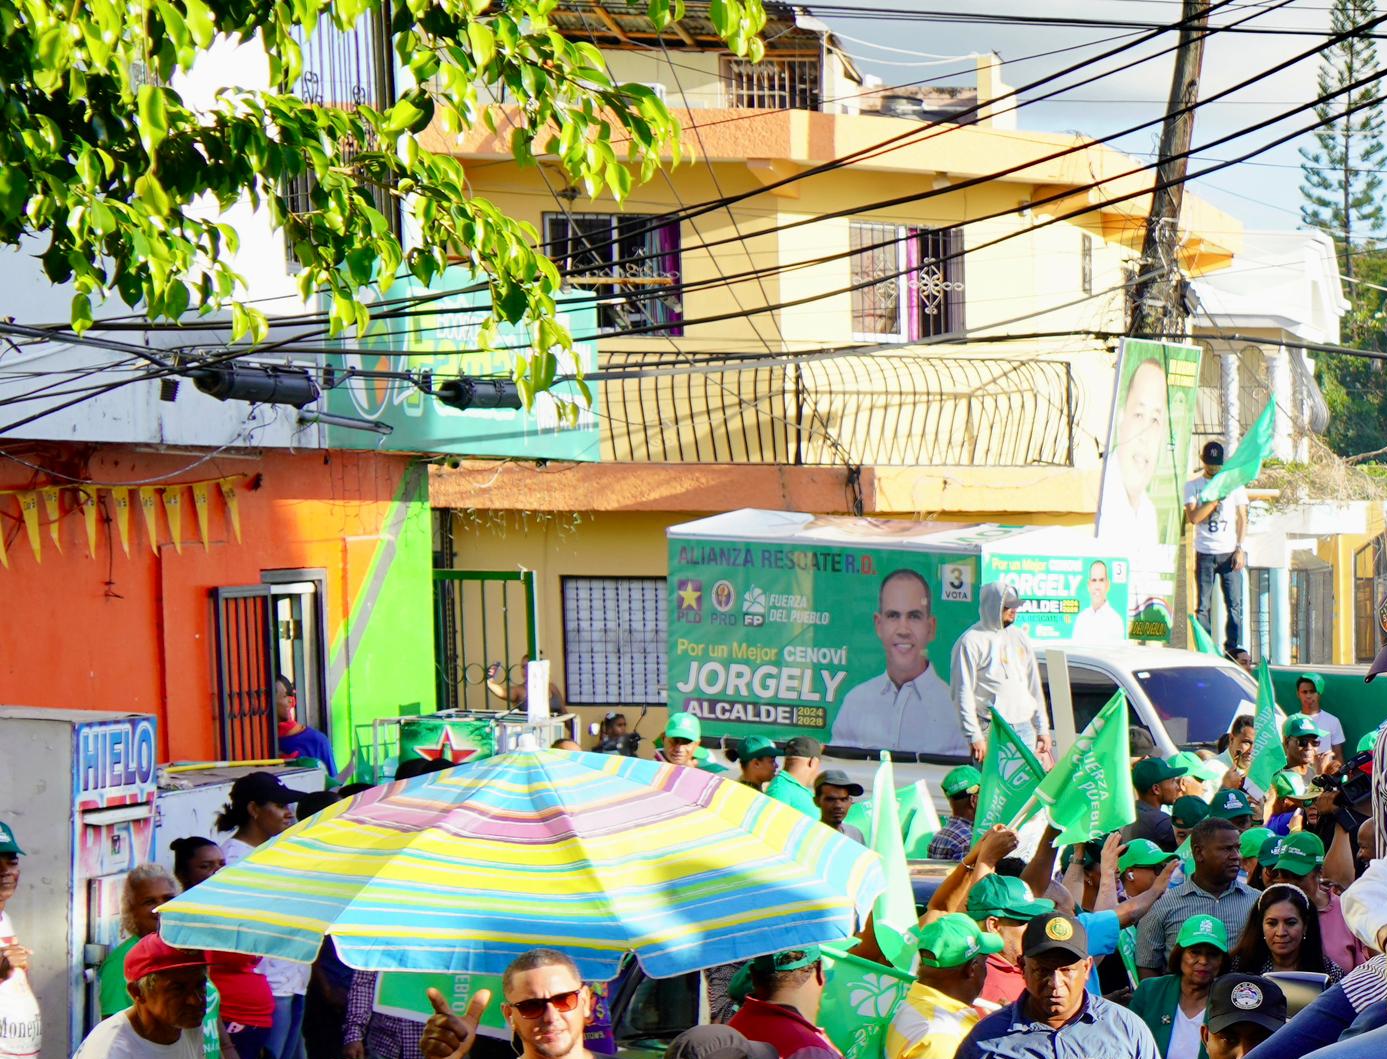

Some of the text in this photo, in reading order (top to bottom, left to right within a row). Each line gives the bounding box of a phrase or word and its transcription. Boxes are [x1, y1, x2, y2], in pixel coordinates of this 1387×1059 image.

[678, 546, 755, 568] ALIANZA
[762, 550, 842, 573] RESCATE
[949, 567, 963, 590] 3
[769, 594, 808, 608] FUERZA
[945, 591, 968, 600] VOTA
[677, 610, 703, 624] PLD
[710, 612, 737, 626] PRD
[744, 616, 763, 626] FP
[769, 609, 831, 625] DEL PUEBLO
[677, 639, 849, 665] Por un Mejor CENOVÍ
[676, 661, 849, 703] JORGELY
[686, 701, 824, 724] ALCALDE 2024
[797, 716, 824, 726] 2028
[81, 724, 155, 792] HIELO
